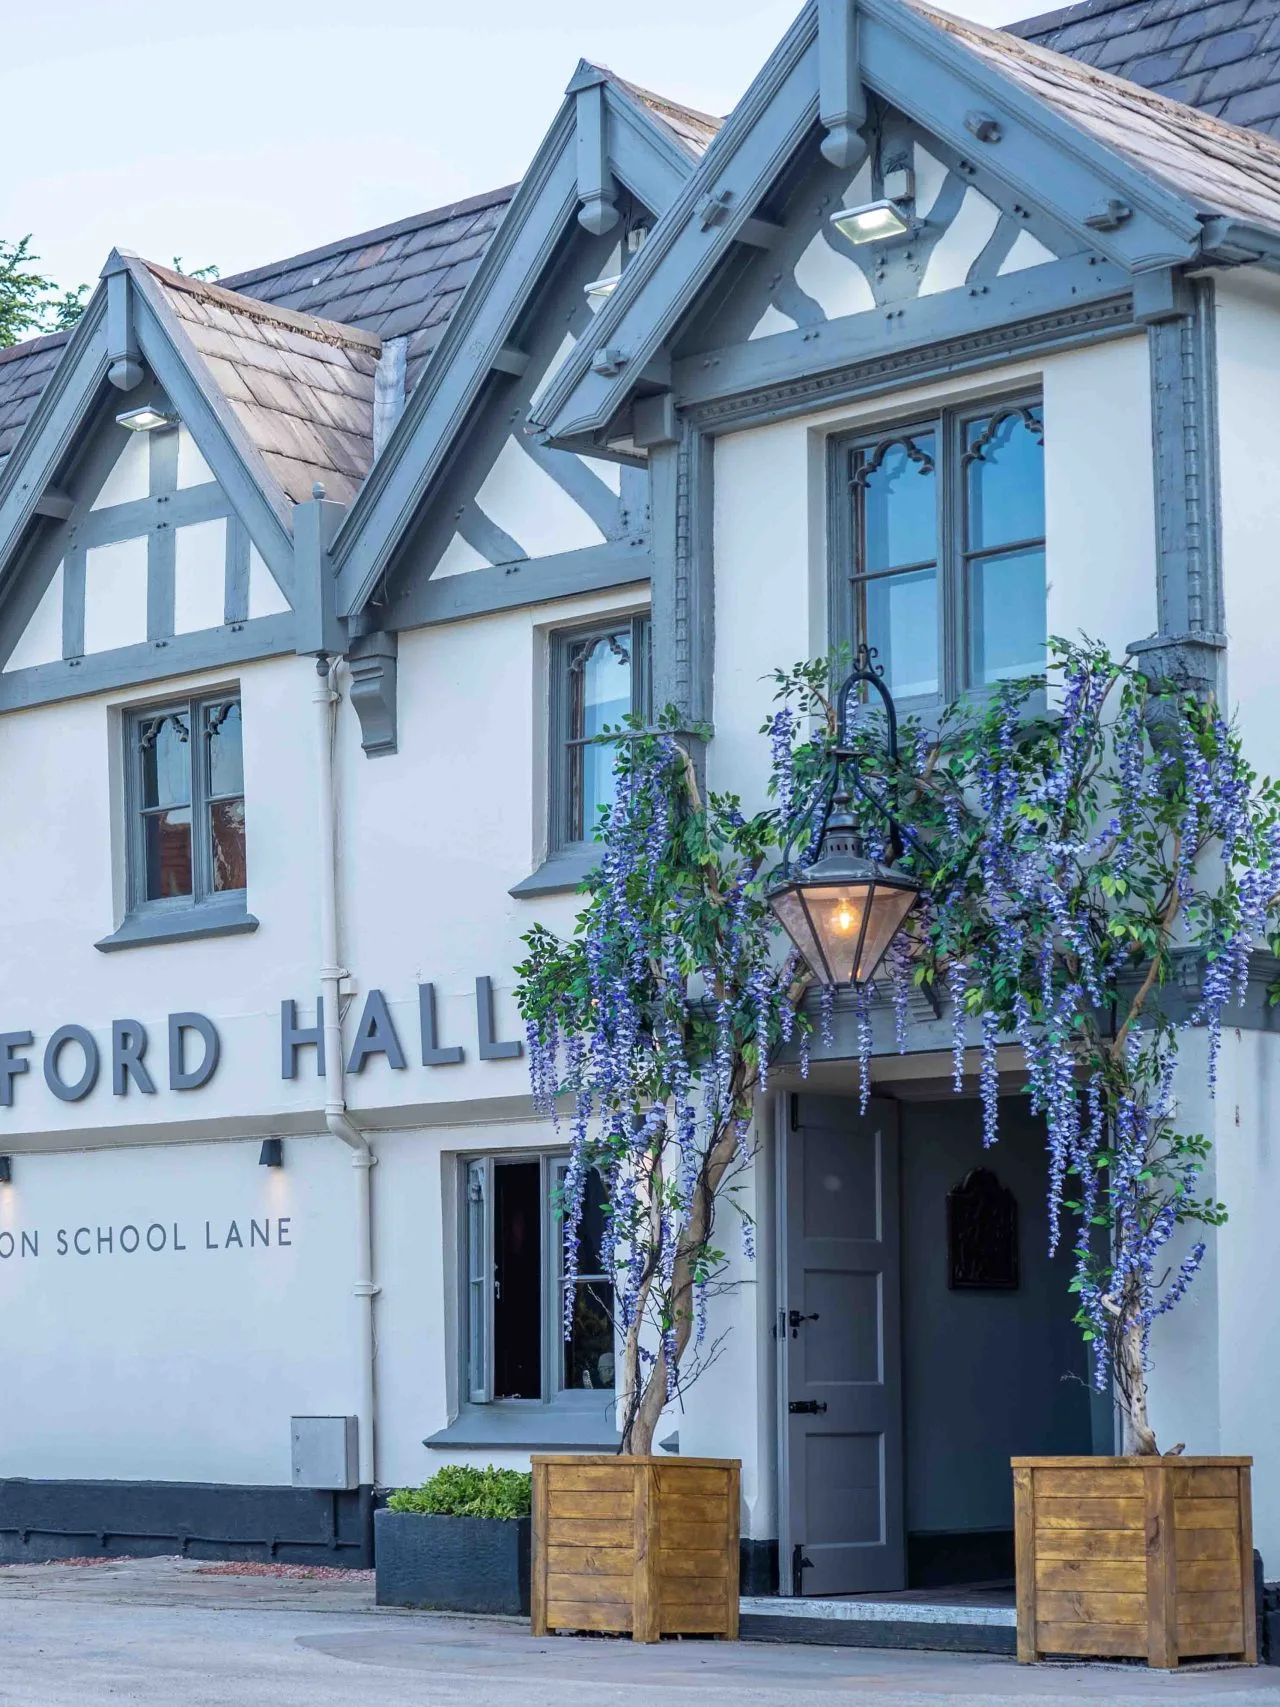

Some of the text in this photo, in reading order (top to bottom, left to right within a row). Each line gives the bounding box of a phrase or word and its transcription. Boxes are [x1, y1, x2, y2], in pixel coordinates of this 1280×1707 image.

[281, 975, 522, 1079] HALL
[56, 1223, 186, 1256] SCHOOL
[205, 1217, 292, 1248] LANE
